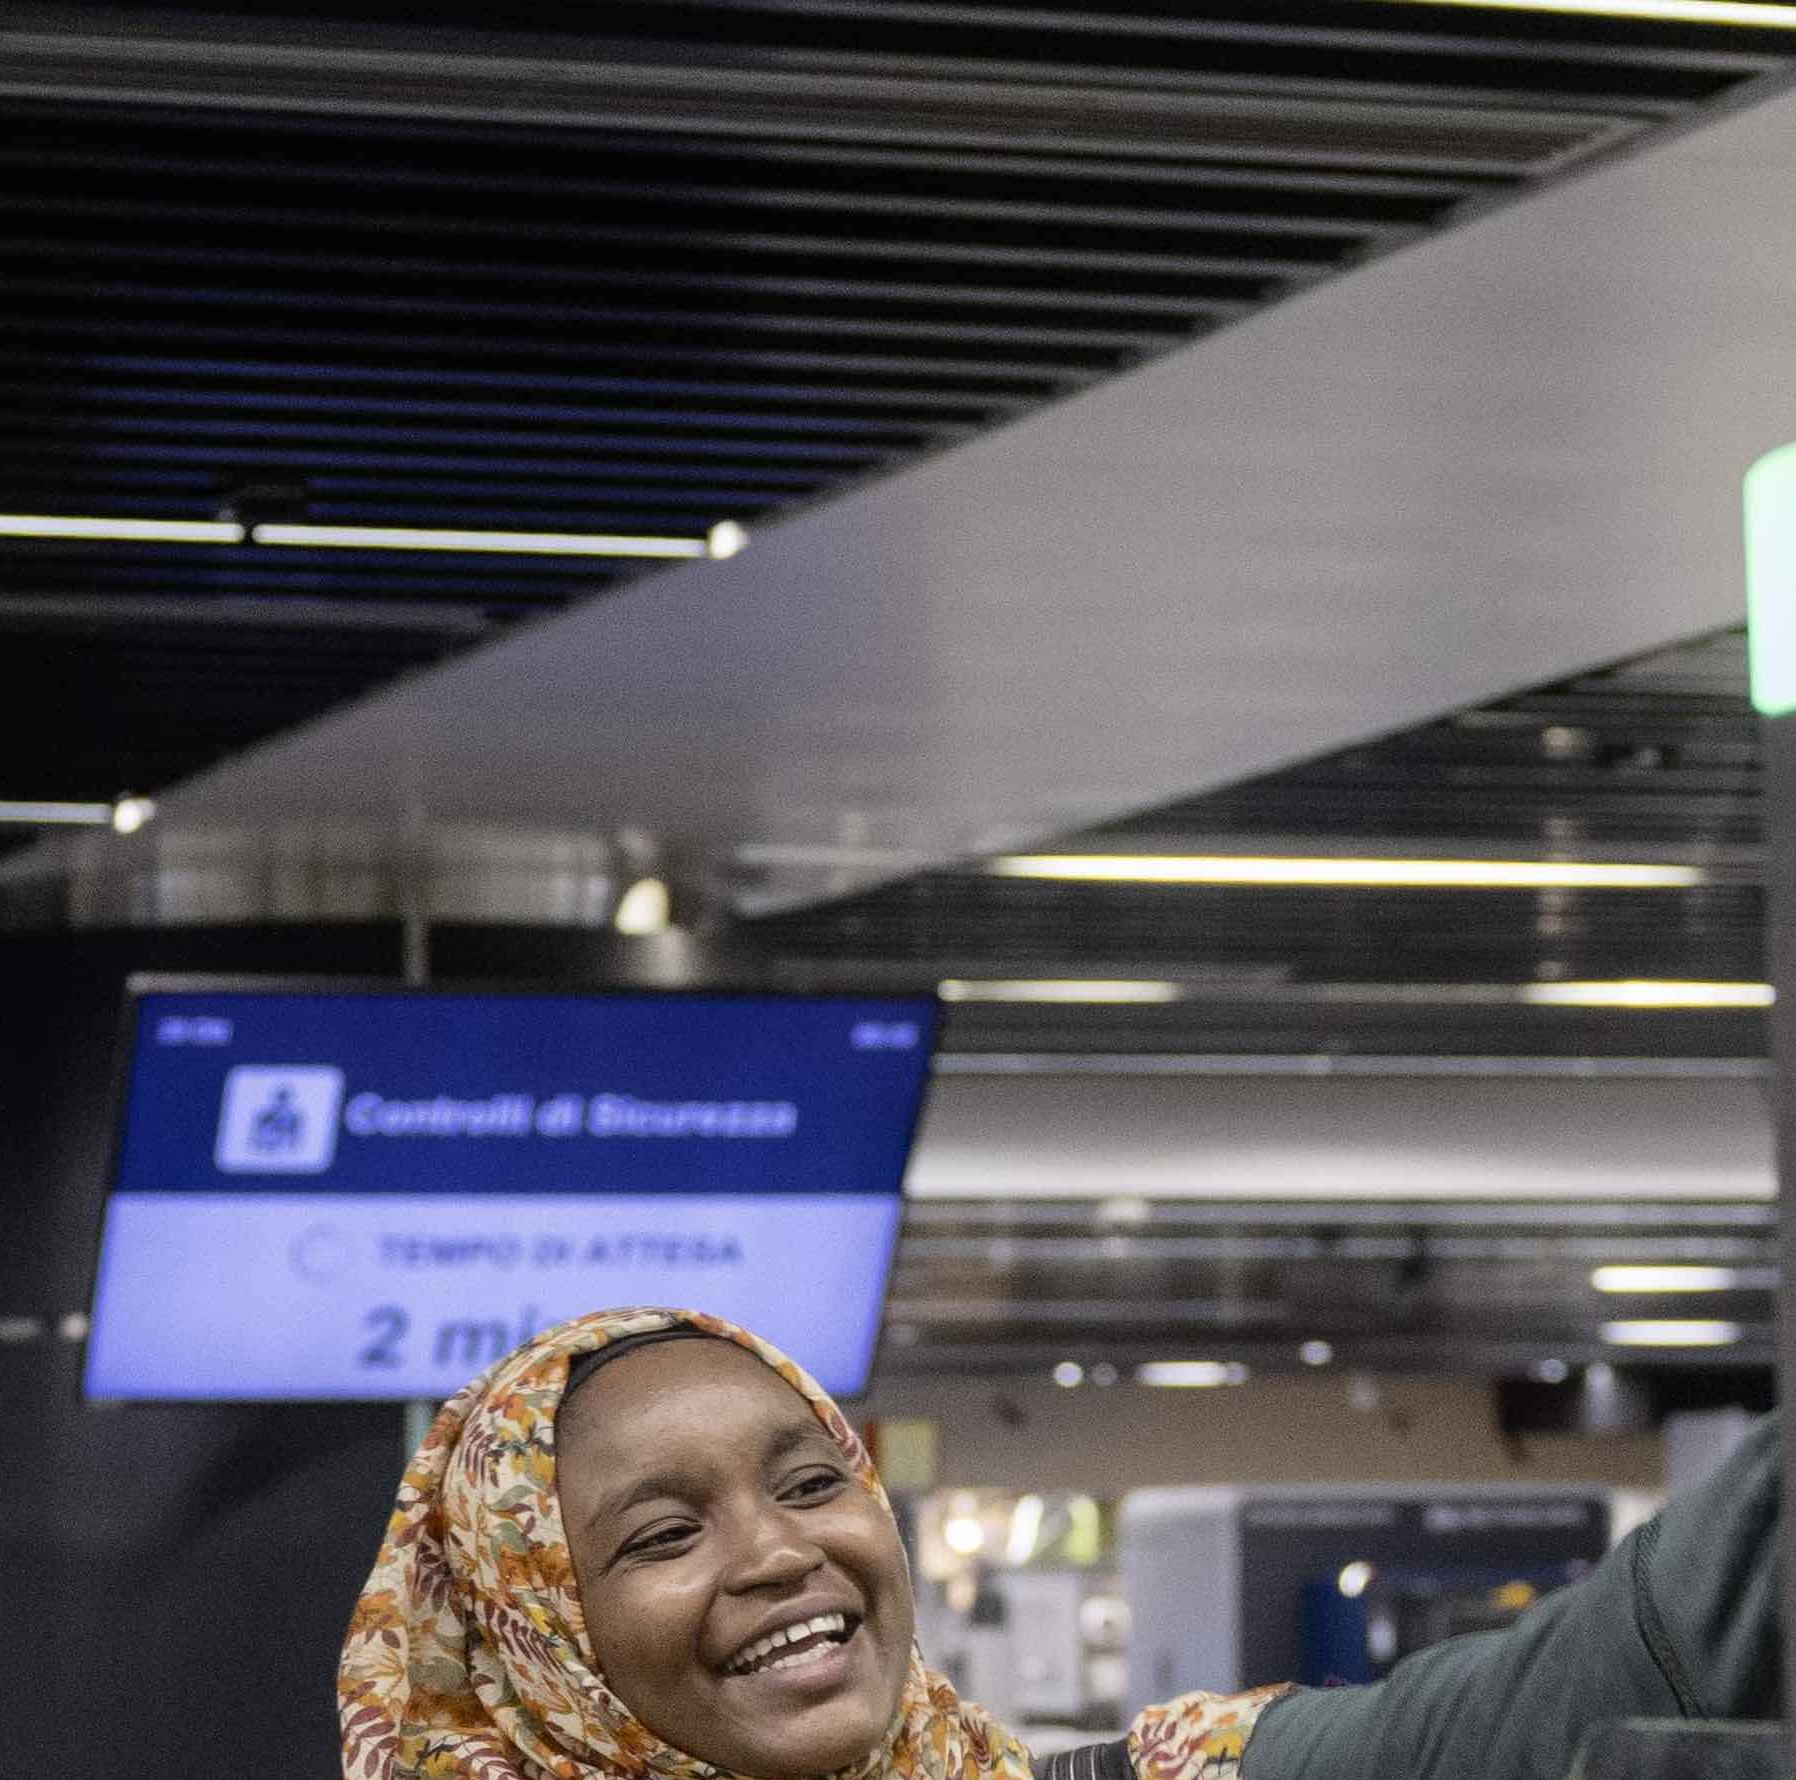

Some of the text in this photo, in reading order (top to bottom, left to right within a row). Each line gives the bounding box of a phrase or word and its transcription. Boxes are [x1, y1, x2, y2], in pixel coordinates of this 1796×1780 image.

[345, 1094, 795, 1138] Controlli di Sicurezza
[380, 1233, 745, 1266] TEMPO DI ATTESA
[360, 1303, 553, 1369] 2 mi
